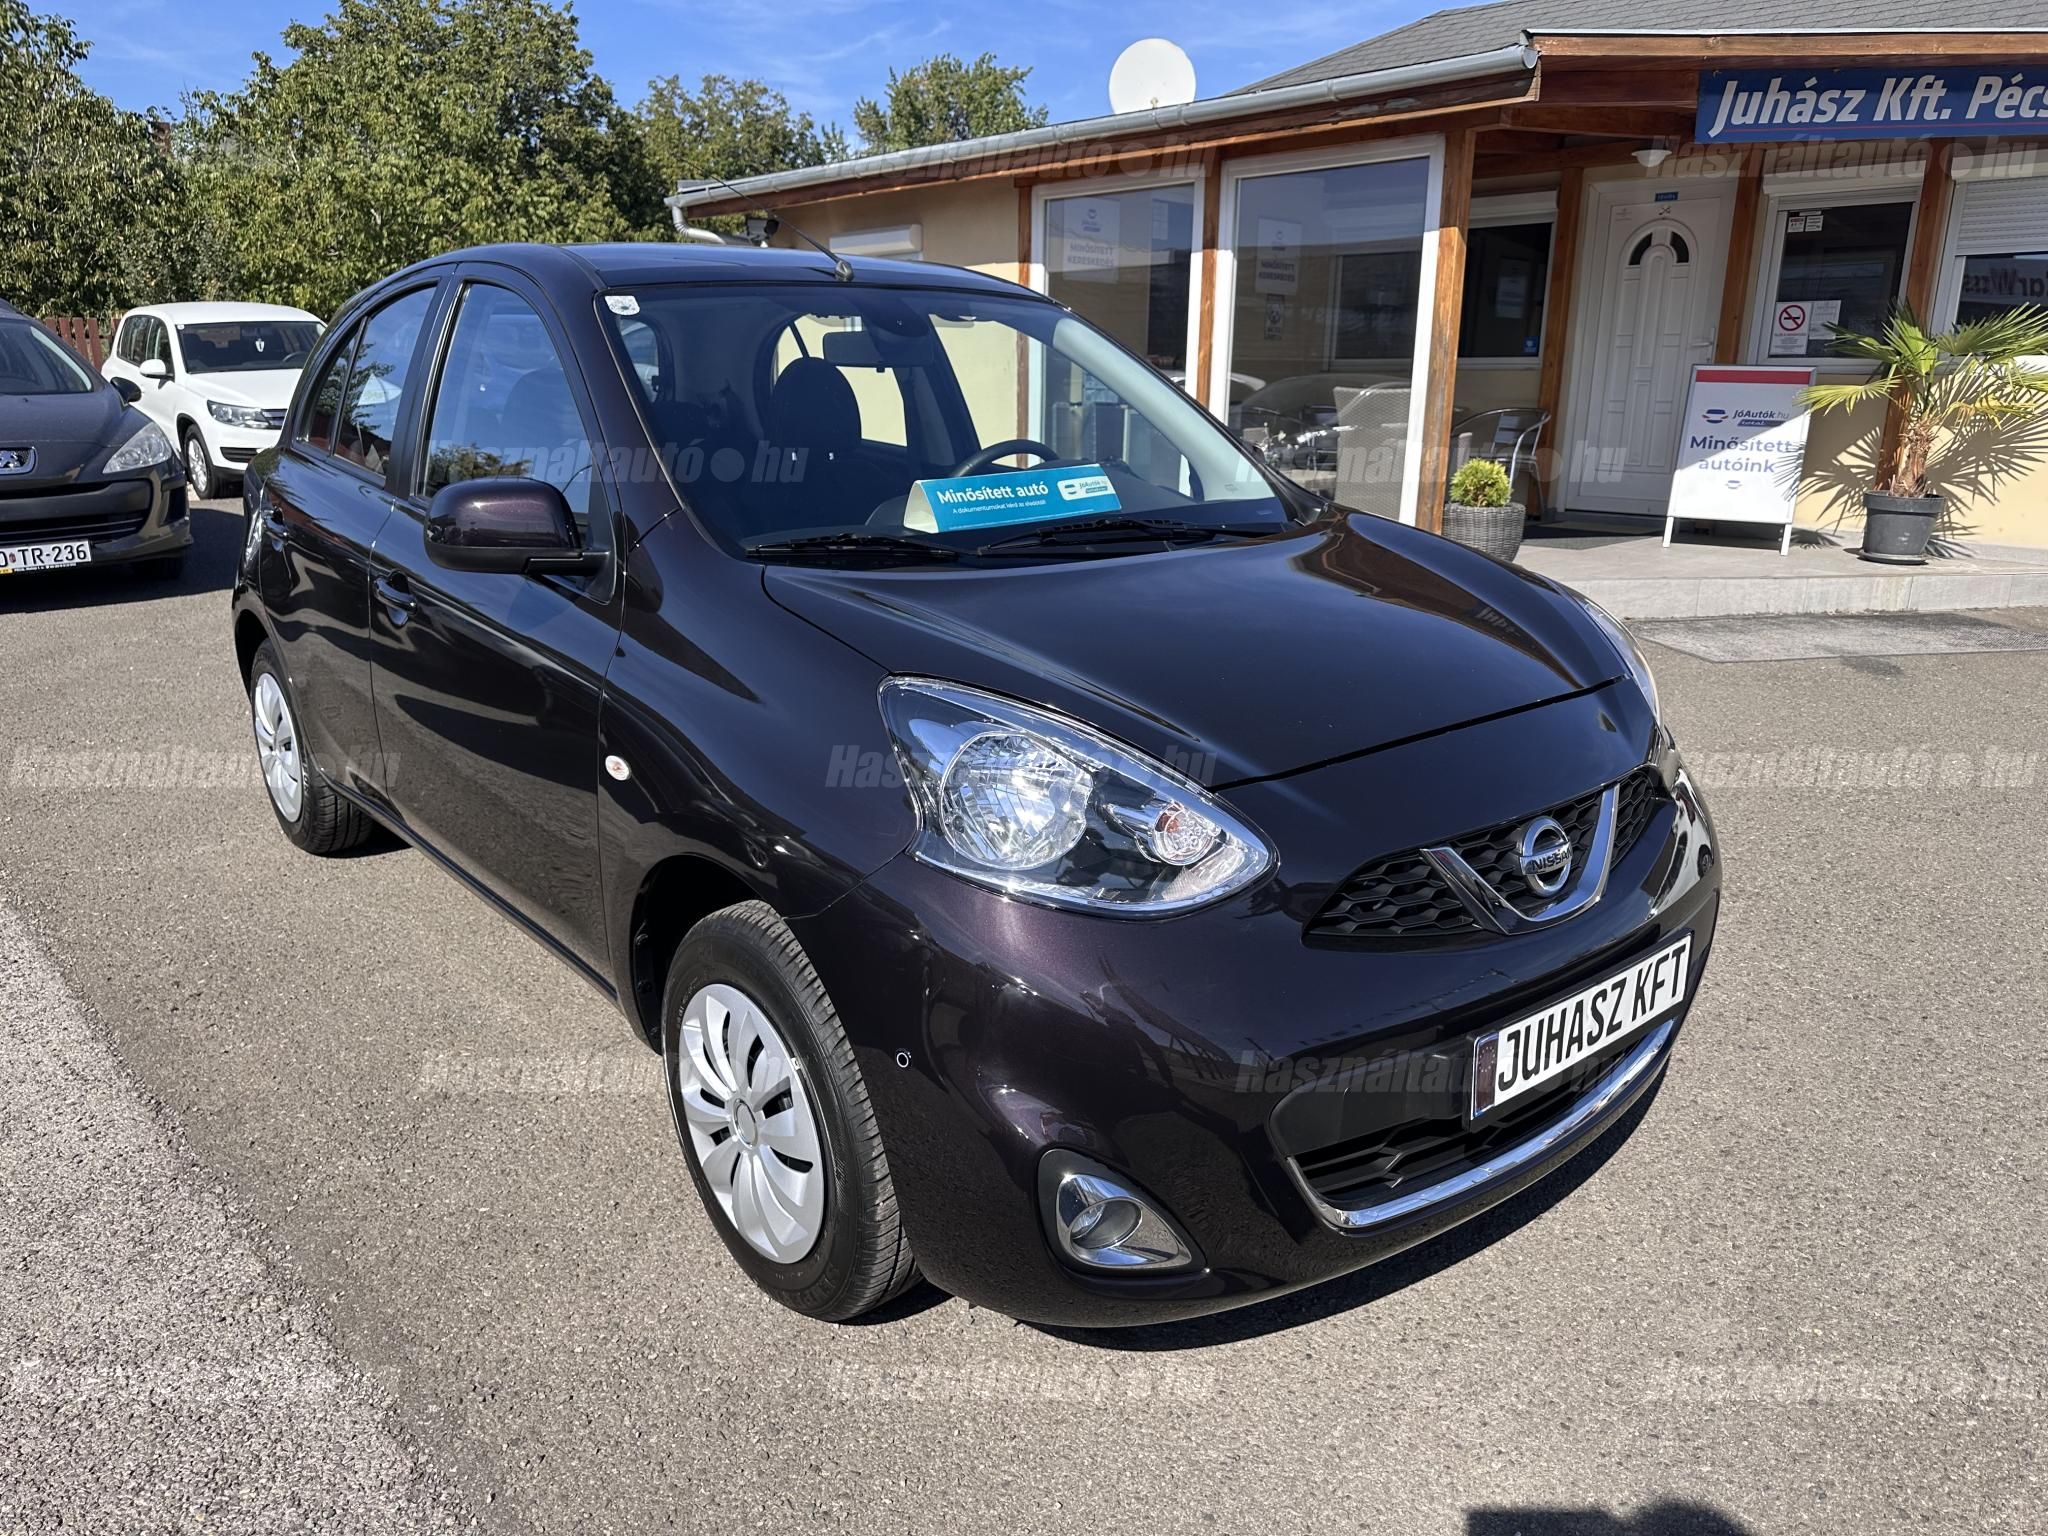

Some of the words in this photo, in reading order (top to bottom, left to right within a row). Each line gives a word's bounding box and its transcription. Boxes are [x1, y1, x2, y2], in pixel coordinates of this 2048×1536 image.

[1707, 76, 1866, 138] Juhász
[1873, 74, 1953, 121] Kft.
[1733, 409, 1790, 420] JóAutók.hu
[1690, 435, 1793, 453] Minősített
[1698, 457, 1775, 473] autóink
[936, 485, 1015, 504] Minősített
[1016, 481, 1049, 497] autó
[17, 543, 87, 566] TR-236
[1531, 848, 1571, 871] NISSAN
[1498, 976, 1627, 1092] JUHASZ
[1632, 947, 1687, 1023] KFT
